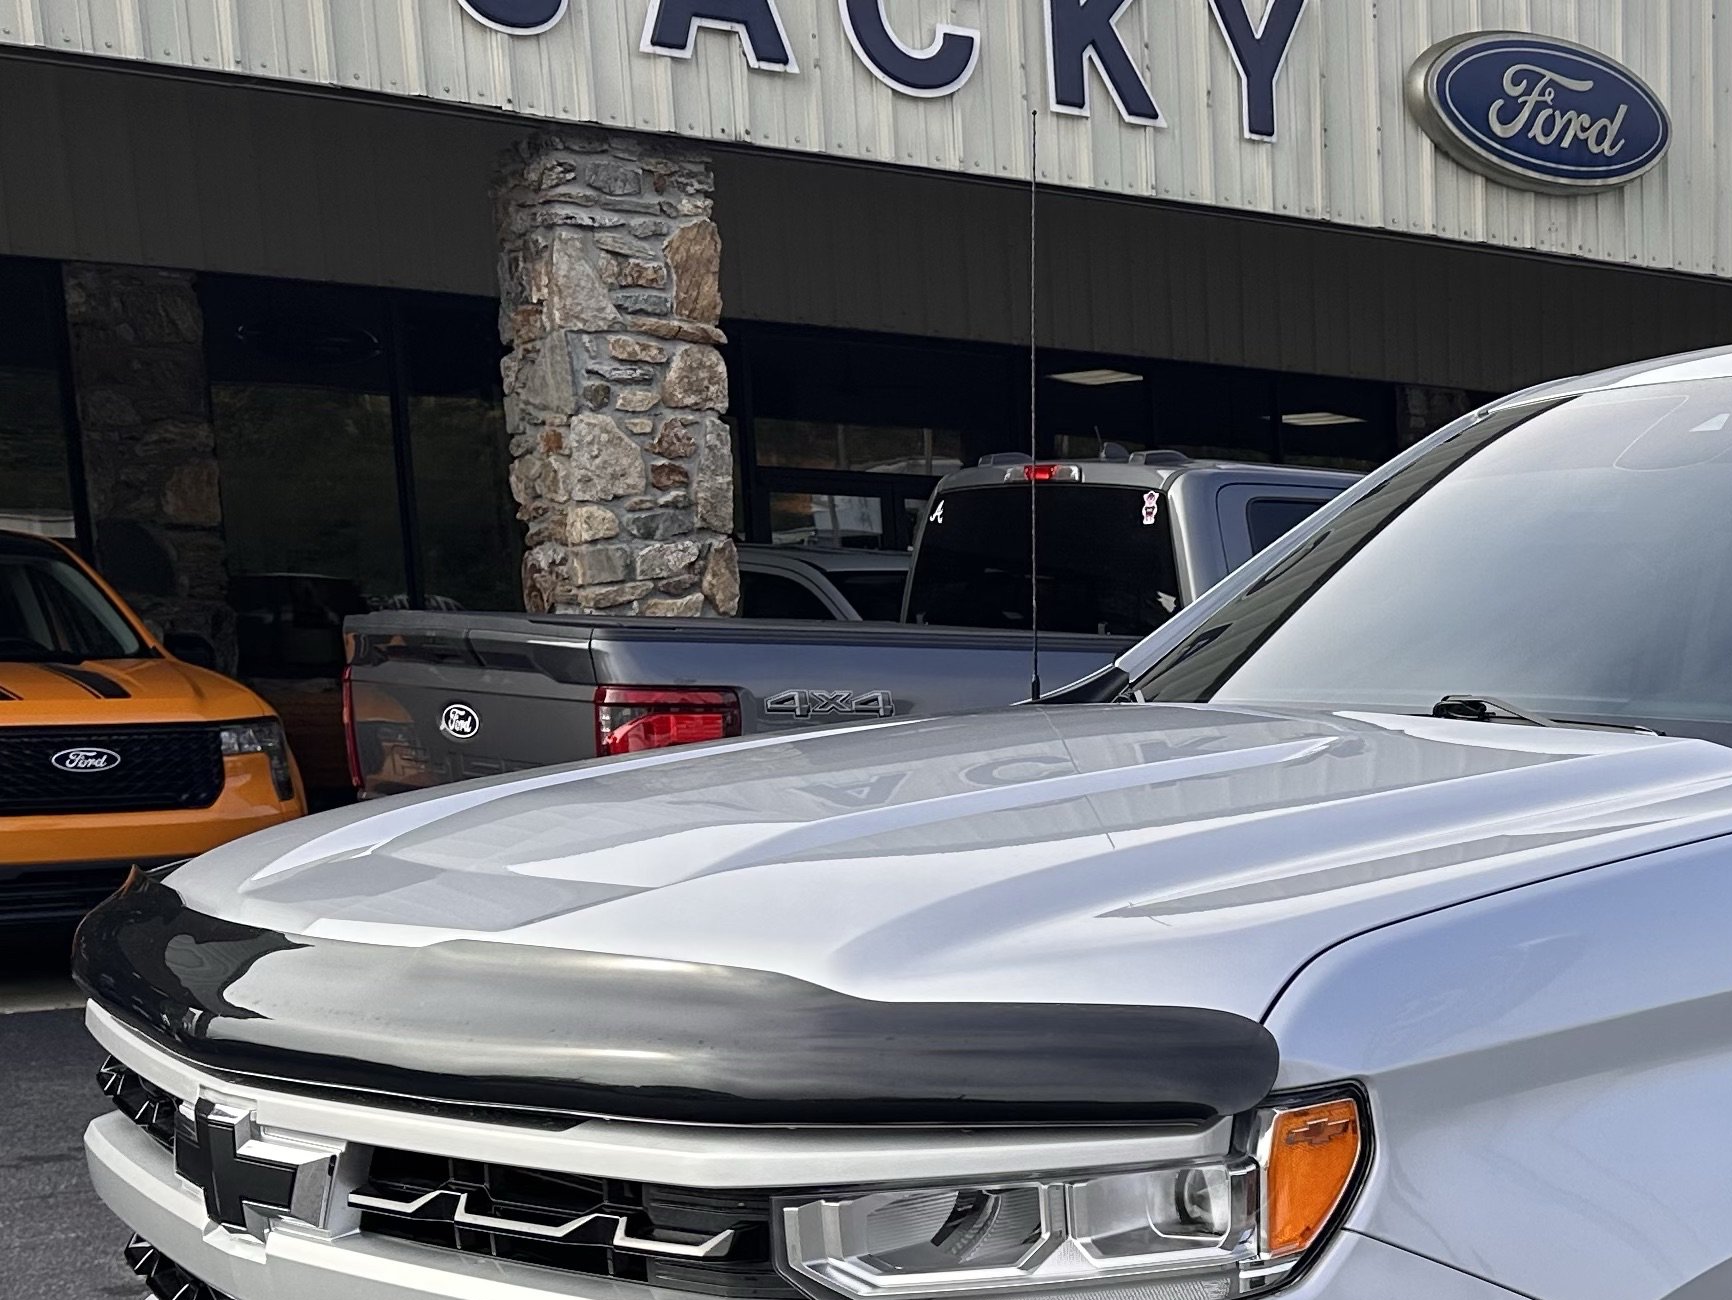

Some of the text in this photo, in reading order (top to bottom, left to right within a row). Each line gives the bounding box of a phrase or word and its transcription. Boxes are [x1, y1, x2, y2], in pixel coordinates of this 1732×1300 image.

[458, 0, 1305, 142] CKY
[1488, 63, 1629, 157] Ford
[448, 708, 472, 732] Ford
[65, 751, 108, 768] Ford
